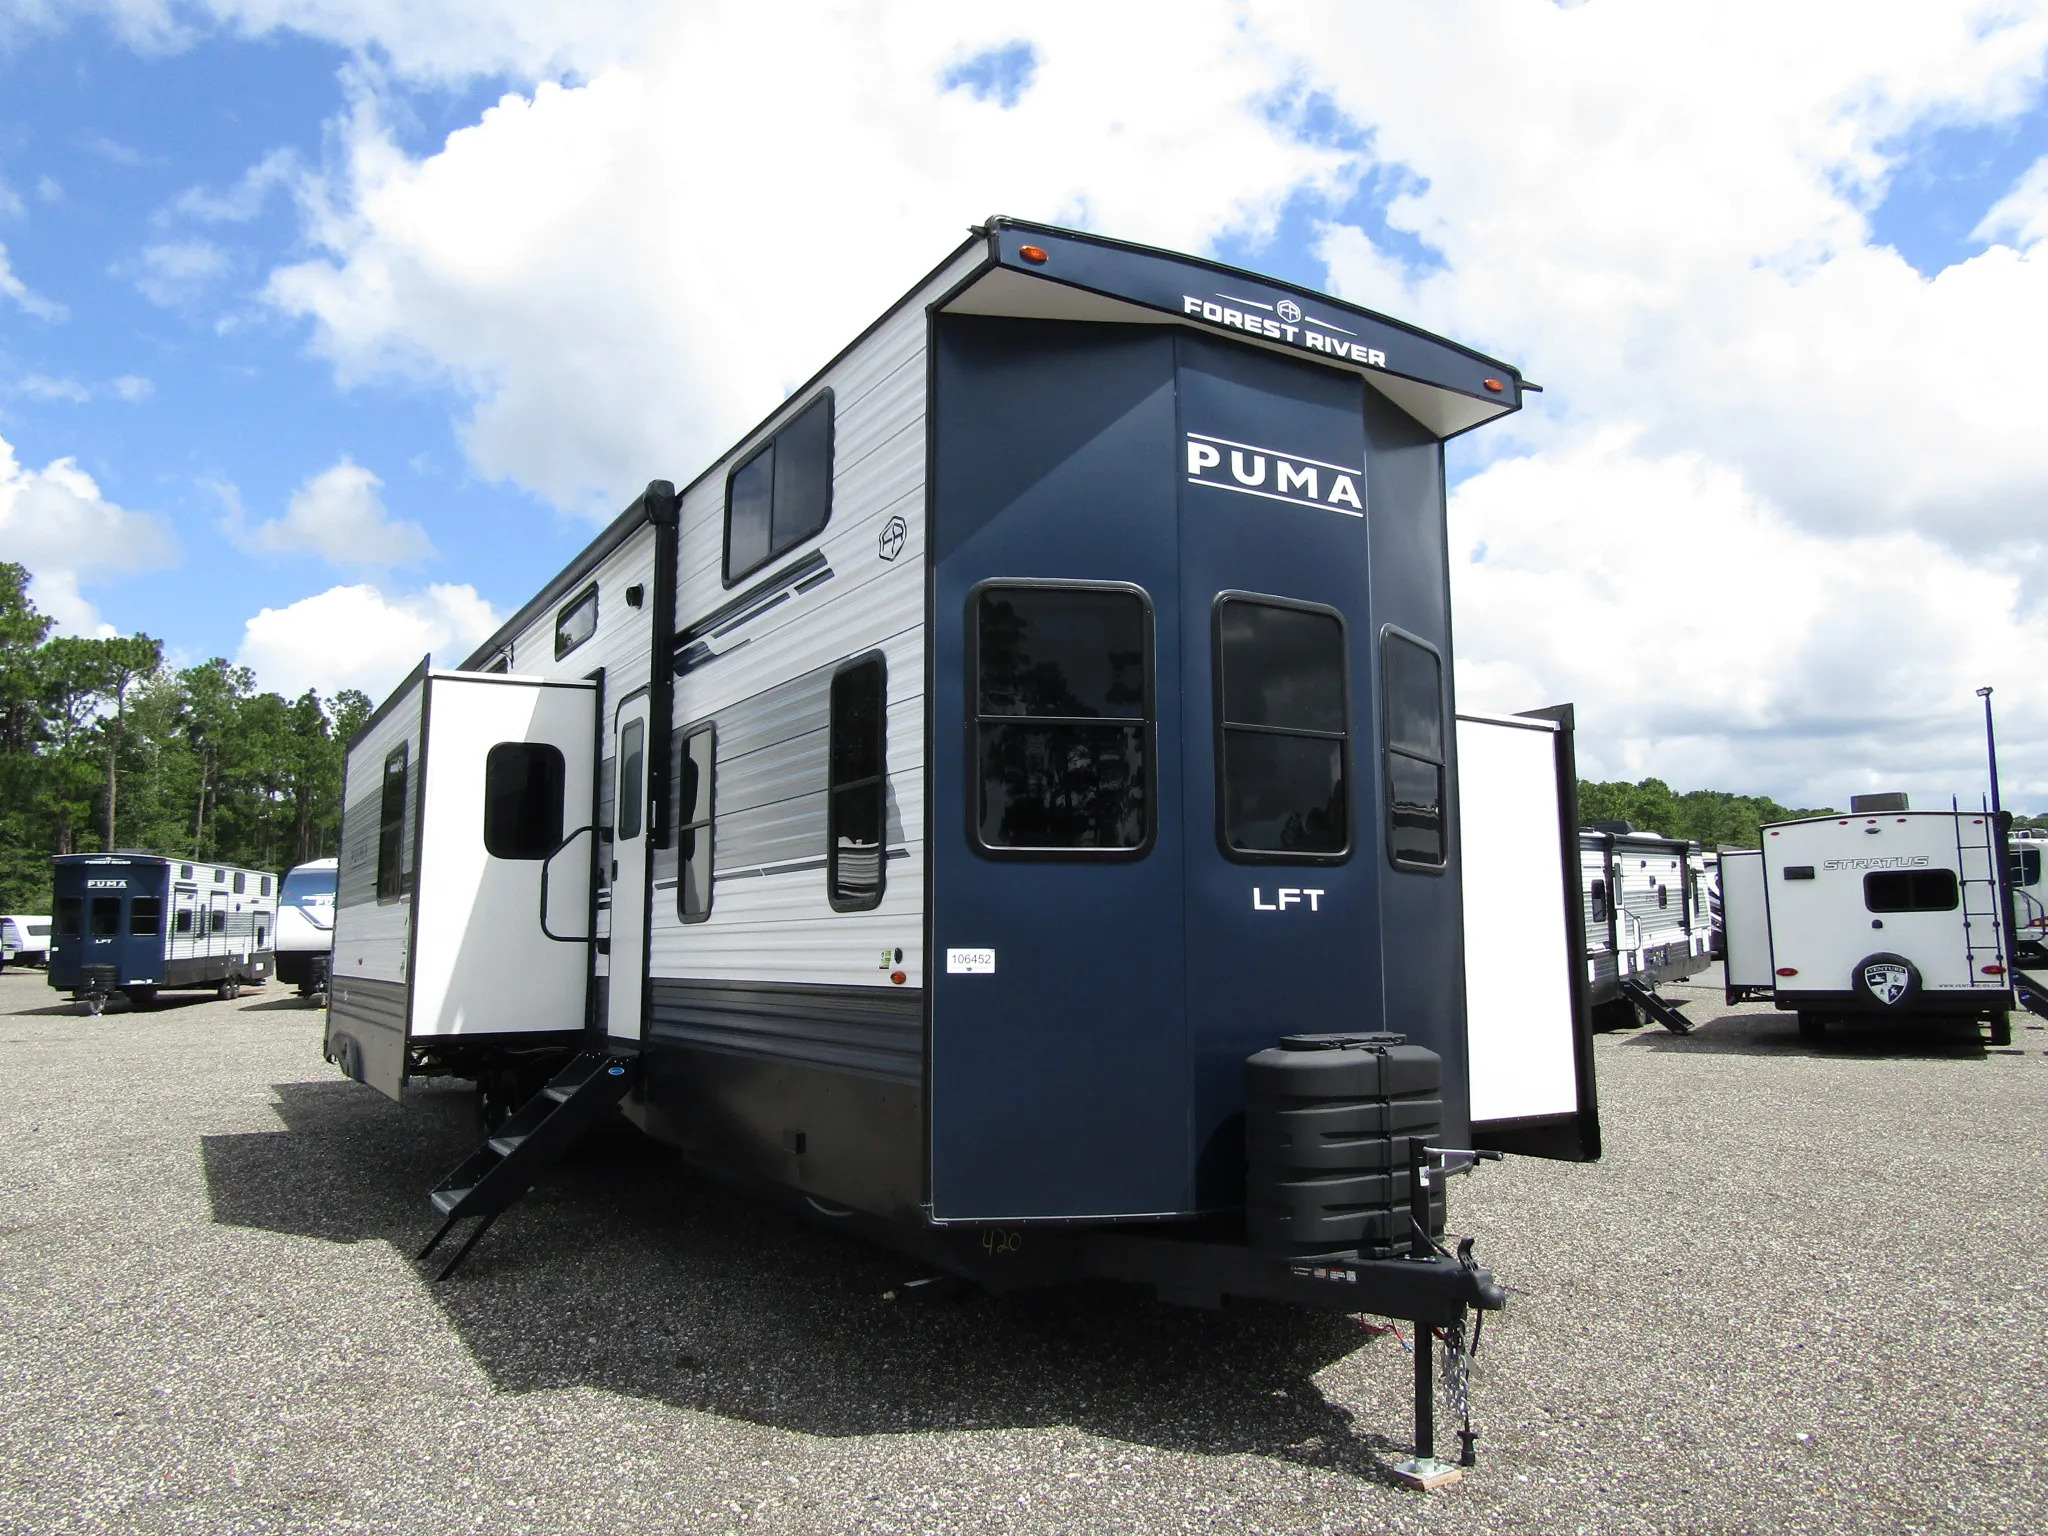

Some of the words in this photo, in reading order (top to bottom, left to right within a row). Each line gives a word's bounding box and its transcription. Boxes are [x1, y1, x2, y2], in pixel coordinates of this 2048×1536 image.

[1183, 295, 1298, 342] FOREST
[1304, 331, 1386, 368] RIVER
[1187, 441, 1363, 509] PUMA
[1823, 856, 1929, 870] STRATUS
[1253, 887, 1325, 911] LFT
[952, 954, 991, 964] 106452
[982, 1228, 1021, 1256] 420
